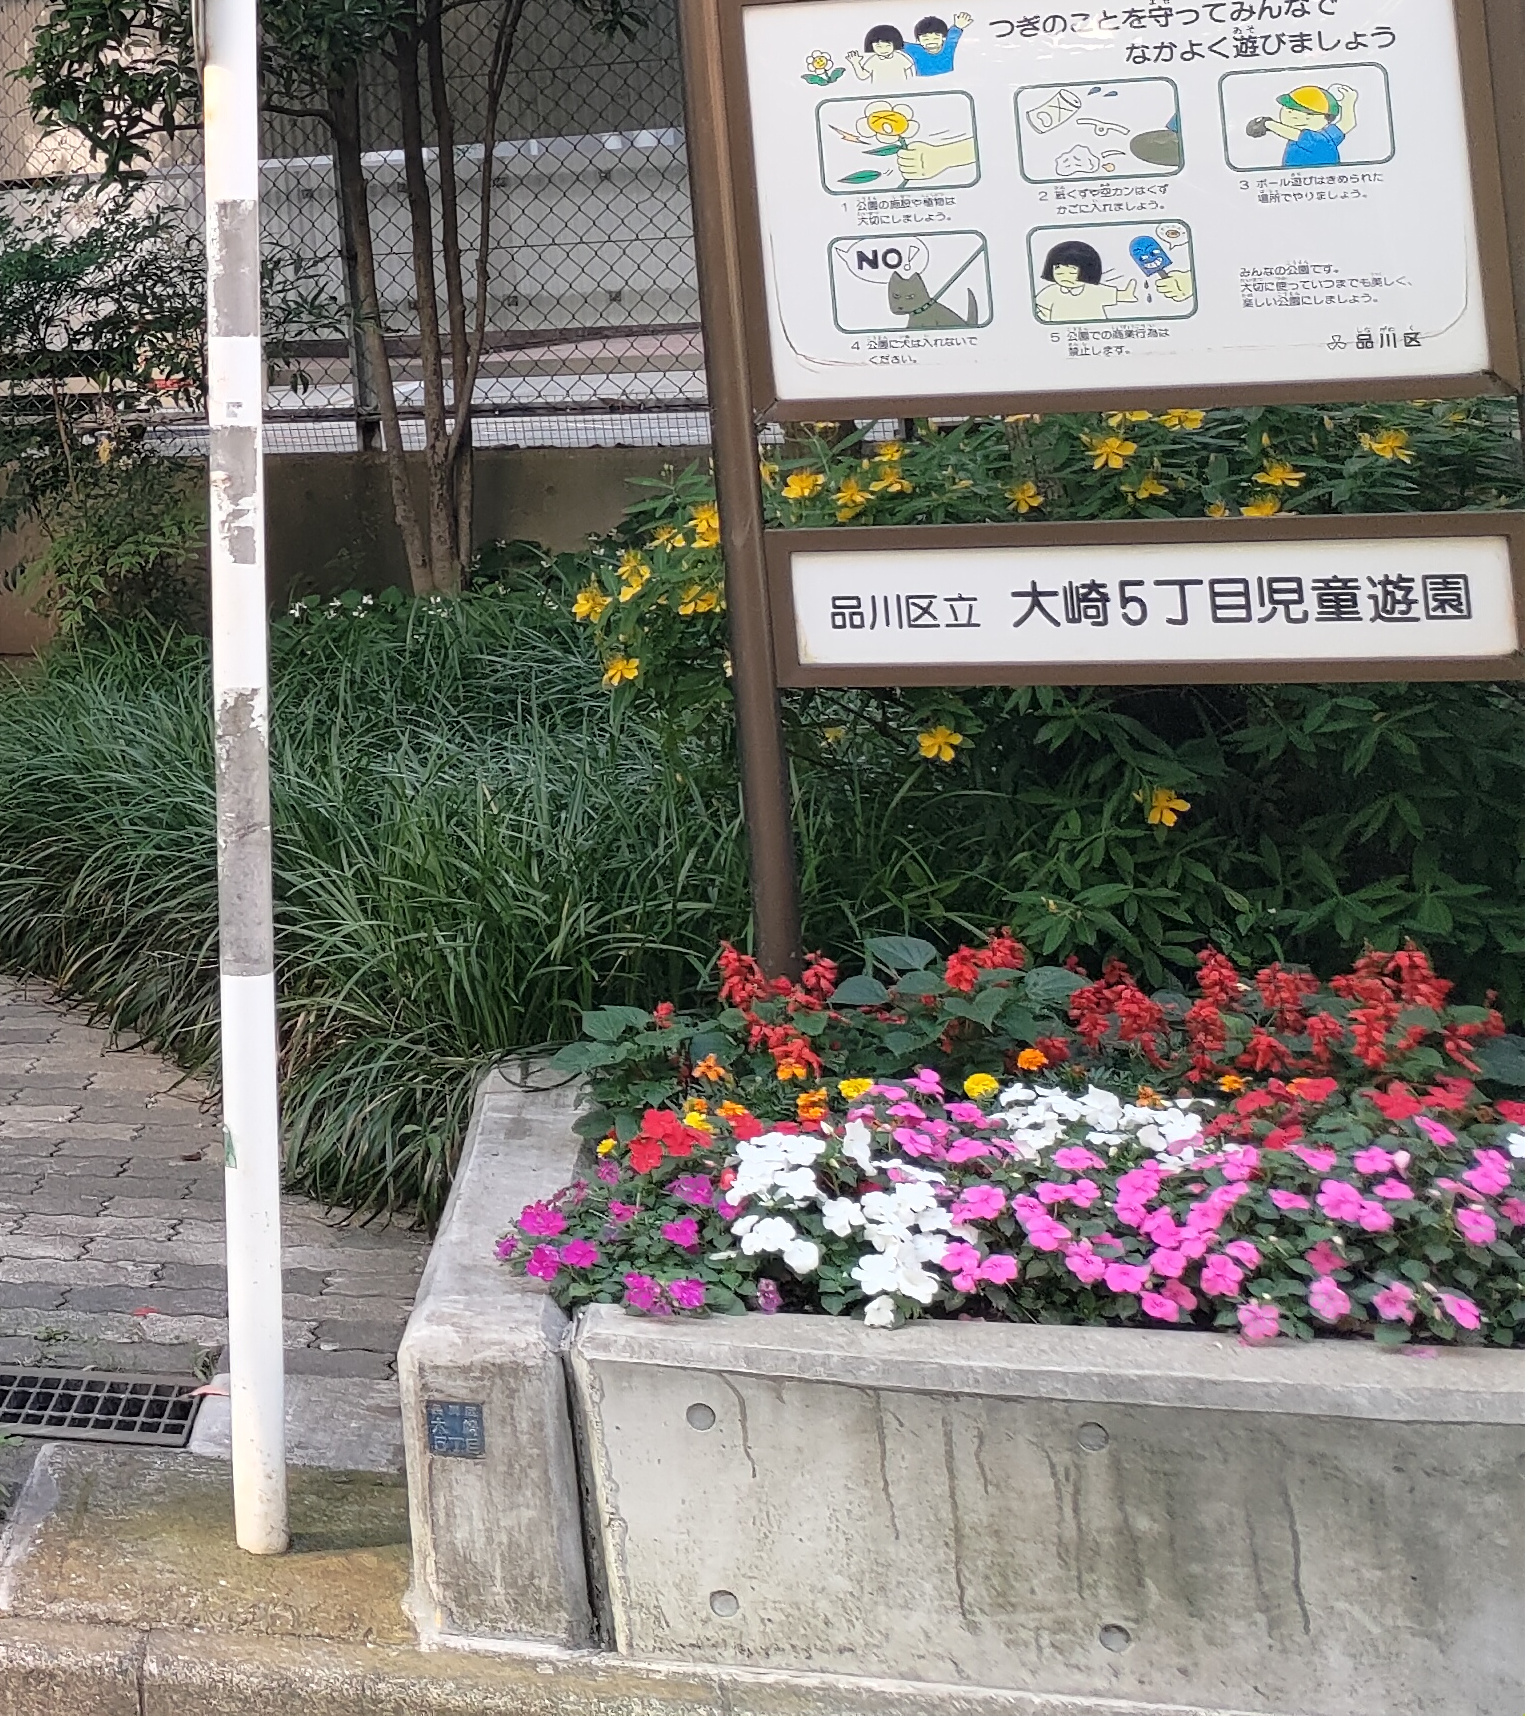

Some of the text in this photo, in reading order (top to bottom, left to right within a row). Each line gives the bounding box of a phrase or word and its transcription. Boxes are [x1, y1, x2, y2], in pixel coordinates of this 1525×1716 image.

[1124, 26, 1396, 65] なかよく遊びましょう
[1239, 180, 1249, 190] 3
[1038, 191, 1048, 202] 2
[841, 202, 848, 212] 1
[1056, 200, 1165, 215] かごに入れましょう。
[857, 212, 952, 227] 大切にしましょう。
[1050, 333, 1060, 342] 5
[1356, 332, 1422, 349] 品川区
[851, 341, 860, 350] 4
[830, 573, 1473, 630] 品川区立 大崎5丁目児童遊園
